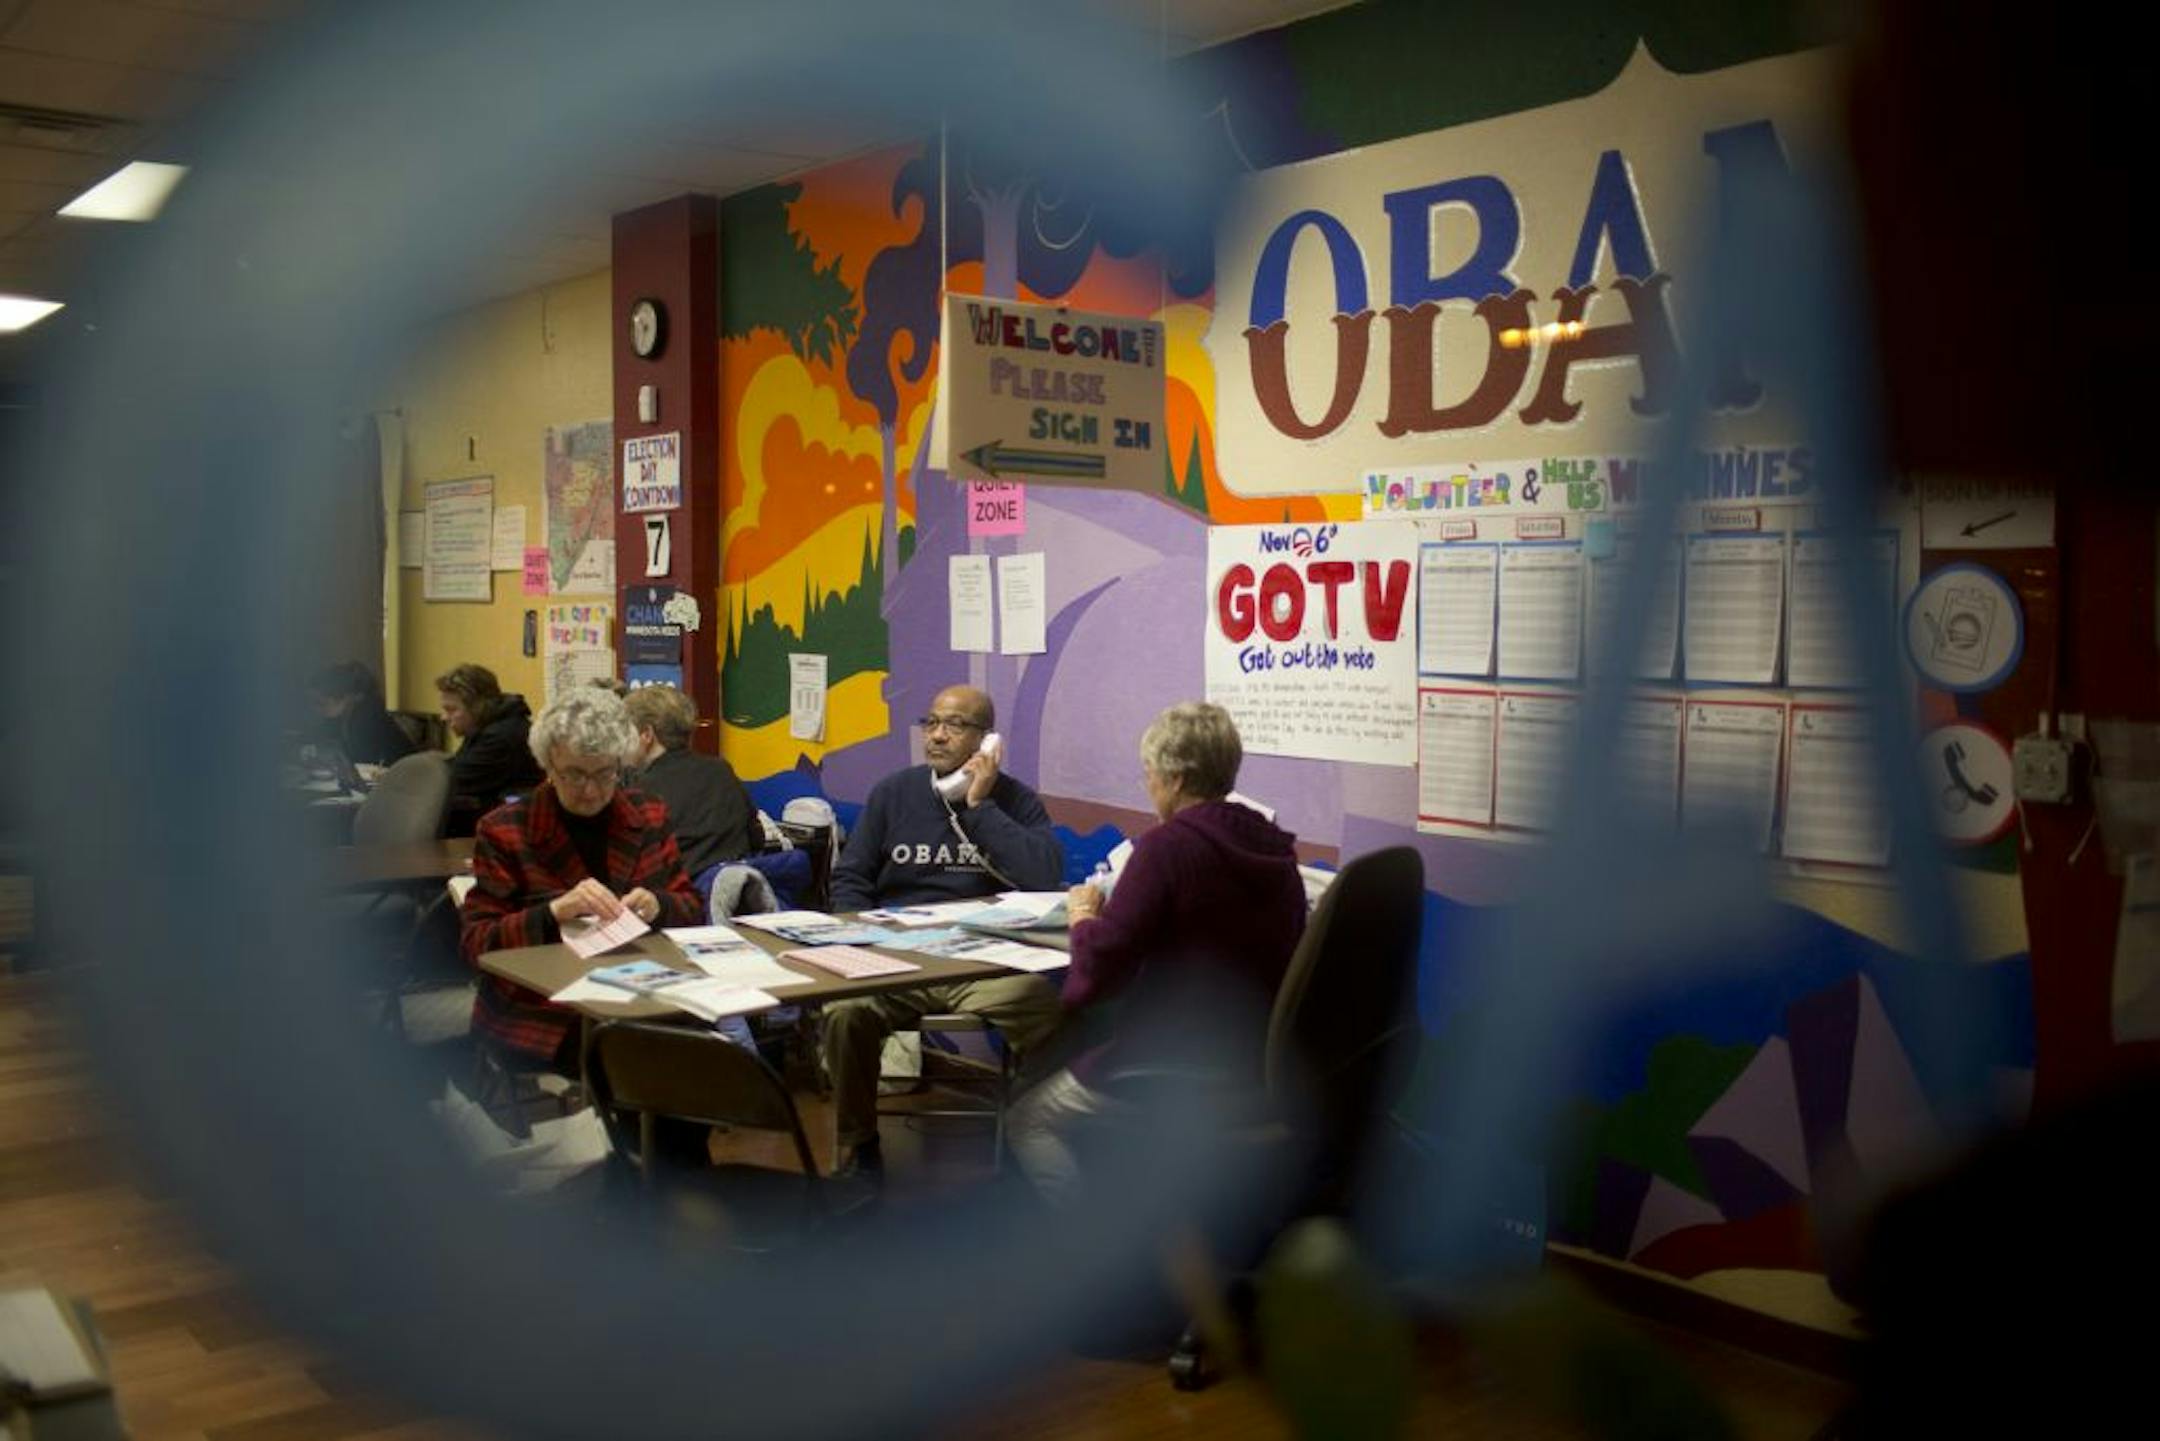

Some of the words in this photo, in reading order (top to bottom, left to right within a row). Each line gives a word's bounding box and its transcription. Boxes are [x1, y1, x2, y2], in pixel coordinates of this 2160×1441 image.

[990, 356, 1107, 405] PLEASE
[1029, 406, 1099, 444] SIGN
[1113, 417, 1151, 449] IN
[629, 436, 676, 462] ELECTION
[641, 462, 656, 482] DAY
[1369, 473, 1510, 510] VOLUNTEER
[1522, 468, 1541, 504] &
[1542, 457, 1597, 484] HELP
[1567, 483, 1600, 509] US
[976, 500, 1017, 522] ZONE
[648, 521, 664, 566] 7
[1260, 530, 1291, 553] Nov
[626, 605, 664, 625] CHAN
[1239, 644, 1275, 673] Get
[1282, 642, 1315, 668] out
[1317, 642, 1338, 669] the
[1344, 645, 1375, 669] vote
[891, 843, 983, 865] OBAM
